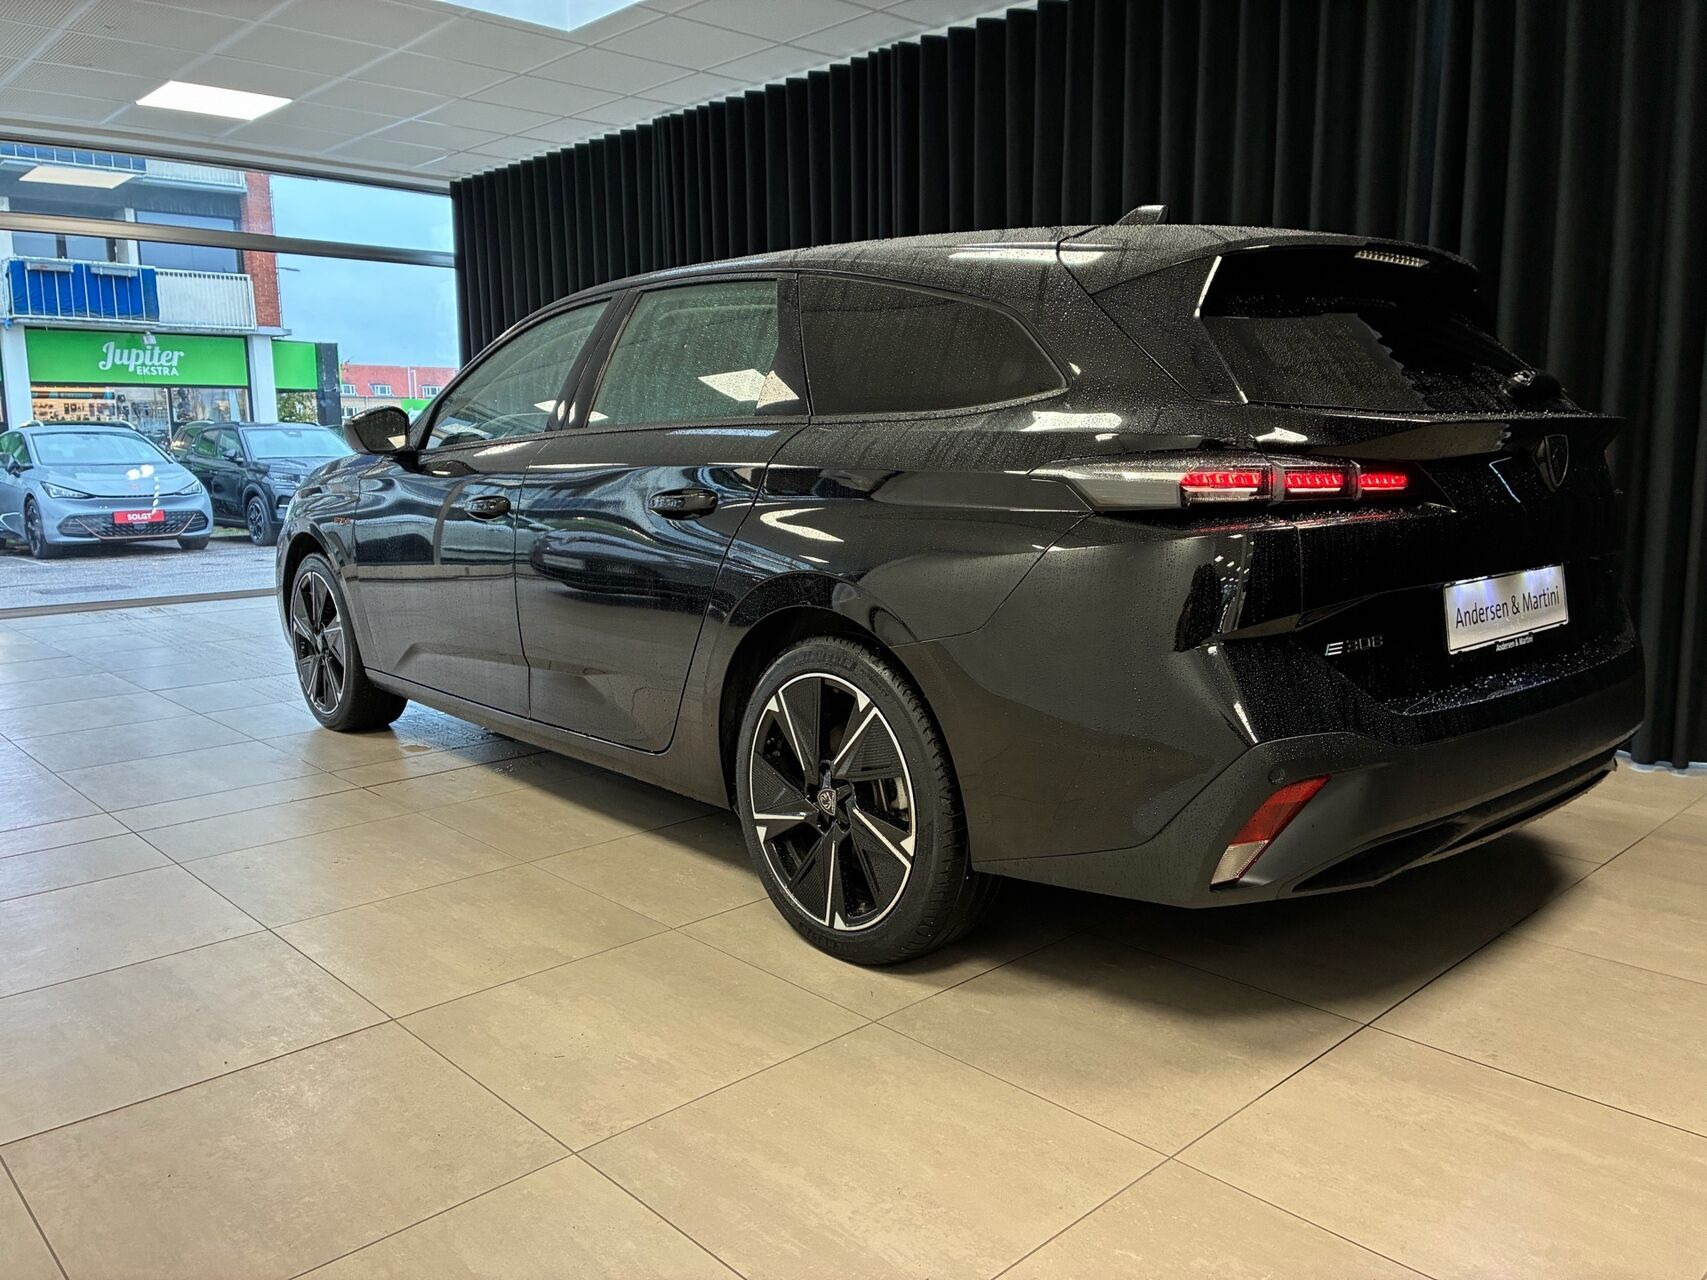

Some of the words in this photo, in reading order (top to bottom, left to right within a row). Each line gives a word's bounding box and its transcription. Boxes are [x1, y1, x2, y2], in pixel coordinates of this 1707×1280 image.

[98, 341, 184, 372] Jupiter
[136, 366, 179, 376] EKSTRA
[127, 513, 152, 521] SOLGT
[1456, 602, 1509, 628] Andersen
[1511, 595, 1520, 615] &
[1522, 585, 1560, 612] Martini
[1495, 640, 1515, 652] Andersen
